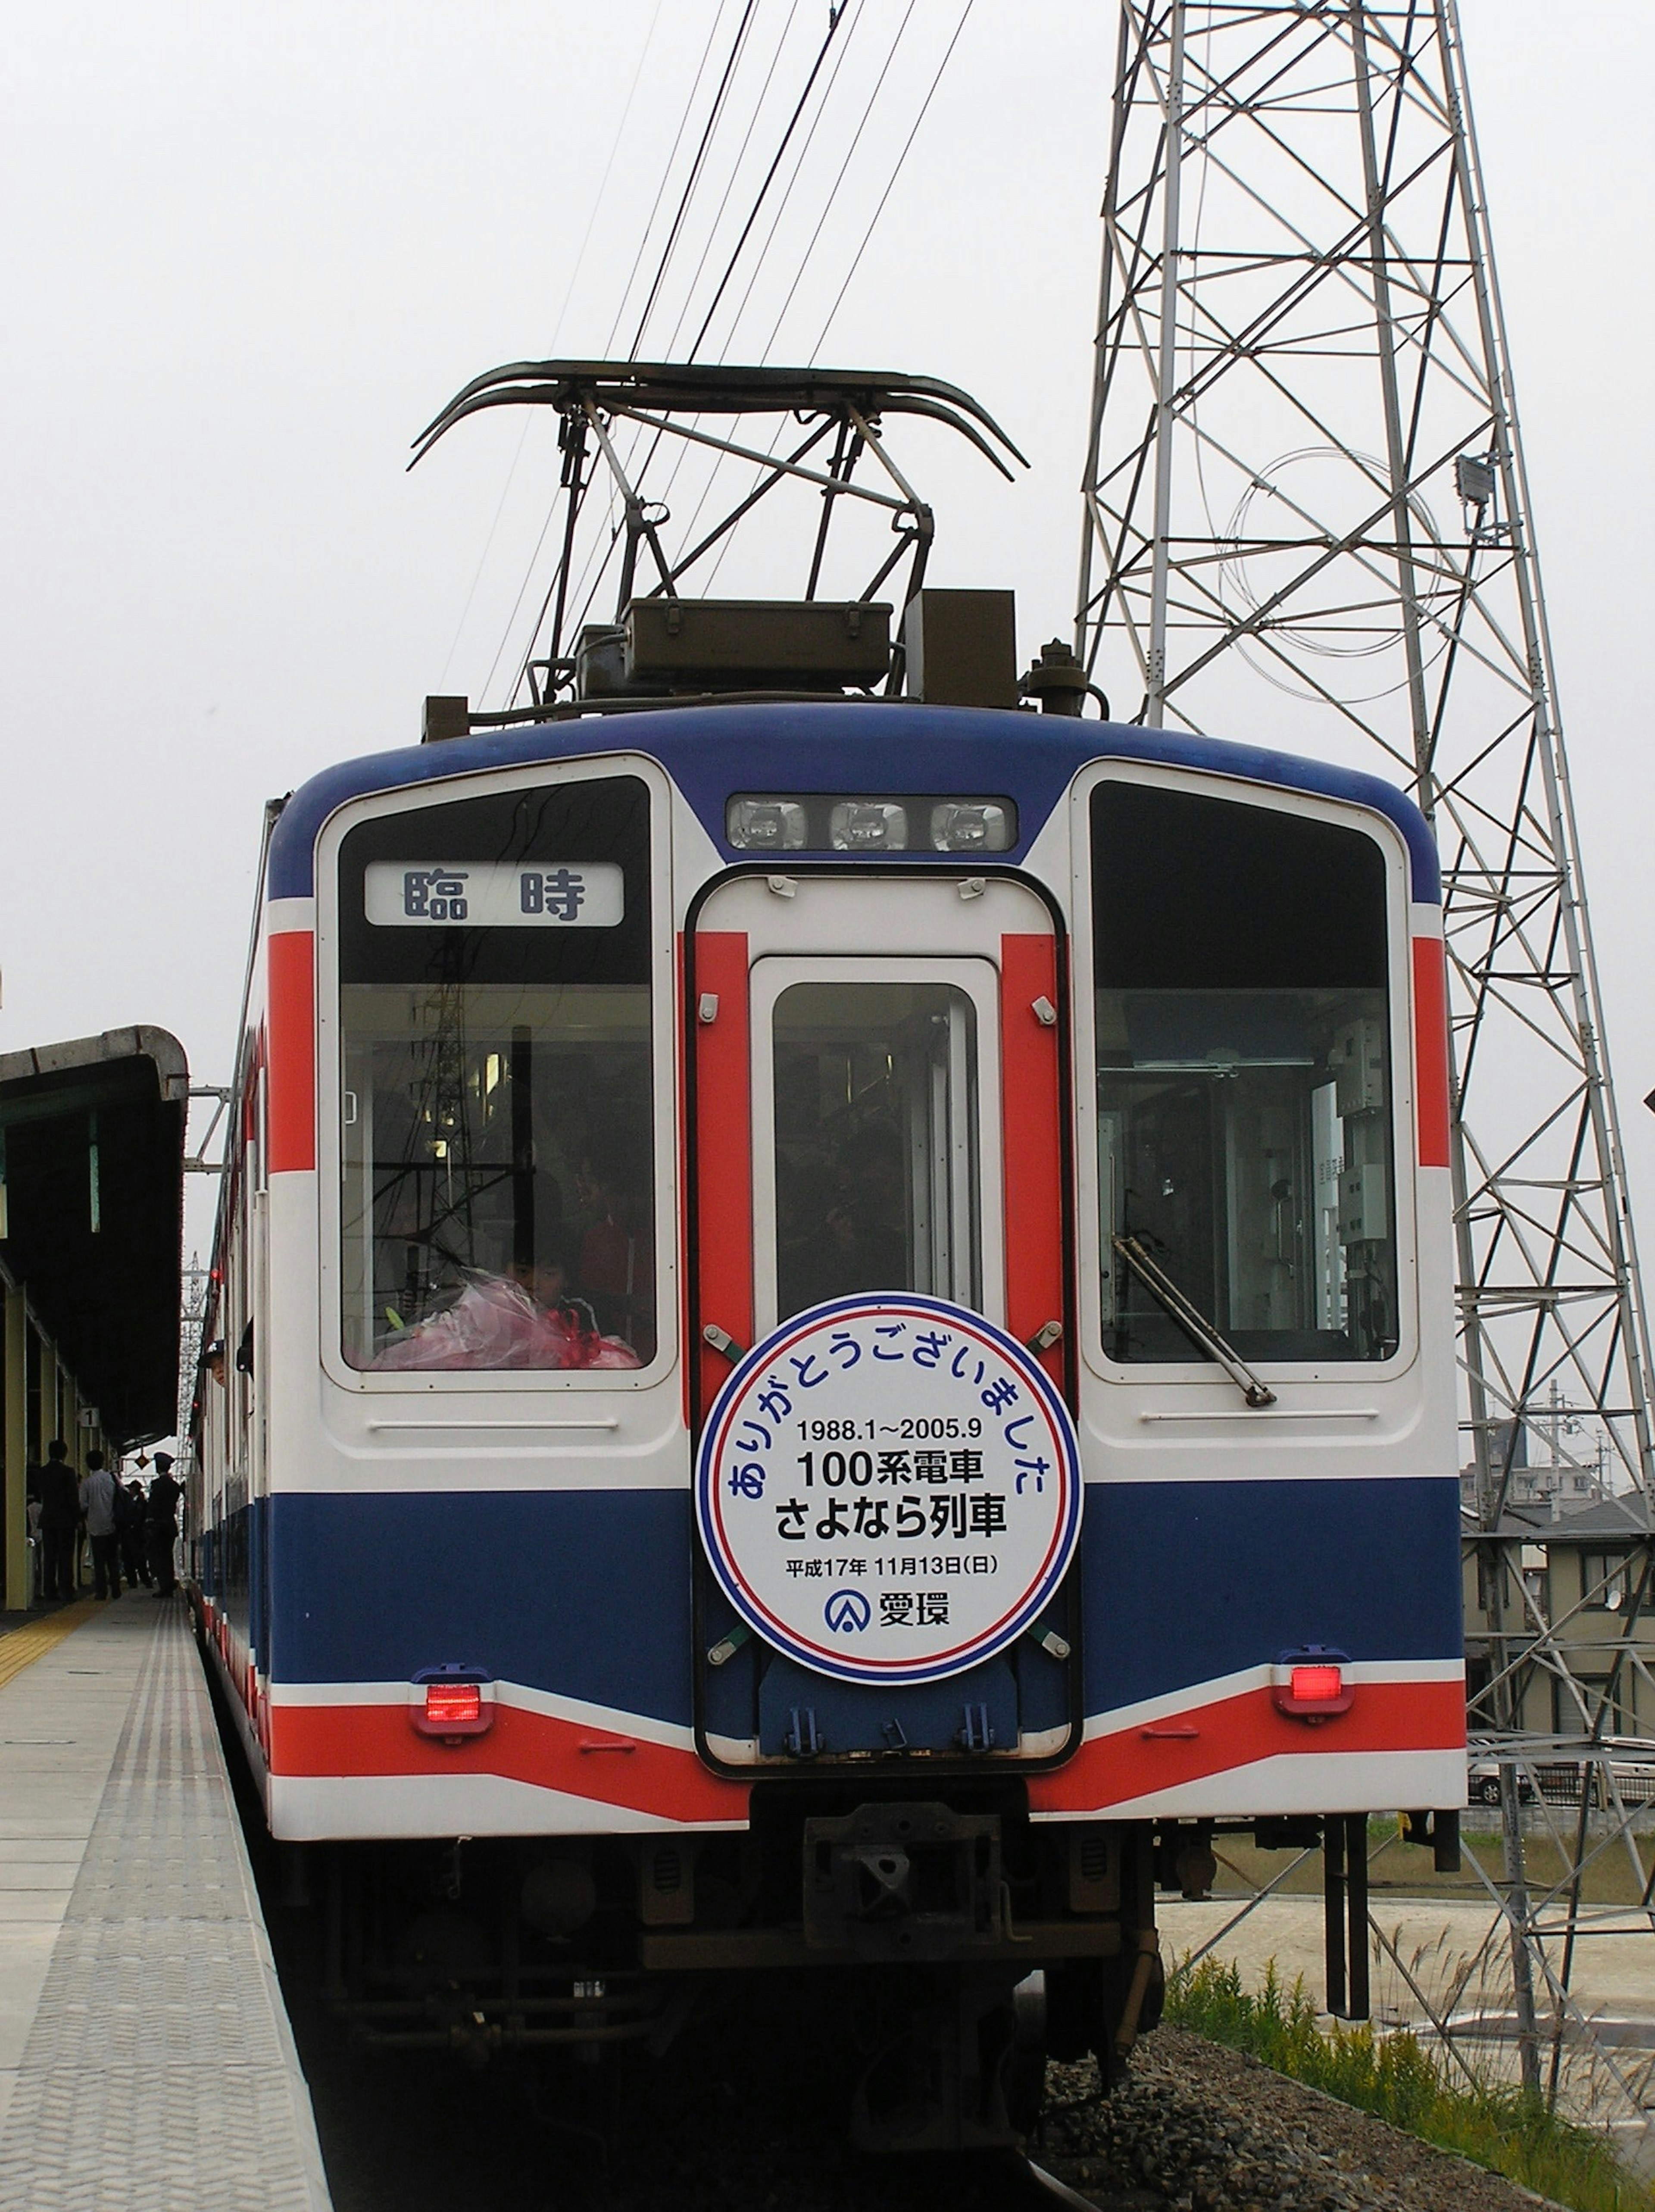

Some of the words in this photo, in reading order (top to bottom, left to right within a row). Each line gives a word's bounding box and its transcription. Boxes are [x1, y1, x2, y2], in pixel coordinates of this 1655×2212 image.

[404, 867, 585, 922] 臨時
[728, 1322, 1050, 1500] ありがとうございました
[797, 1449, 984, 1487] 100系電車
[775, 1493, 1007, 1540] さよなら列車
[785, 1558, 868, 1578] 平成17年
[874, 1555, 999, 1576] 11月13日(日)
[879, 1592, 950, 1628] 愛環
